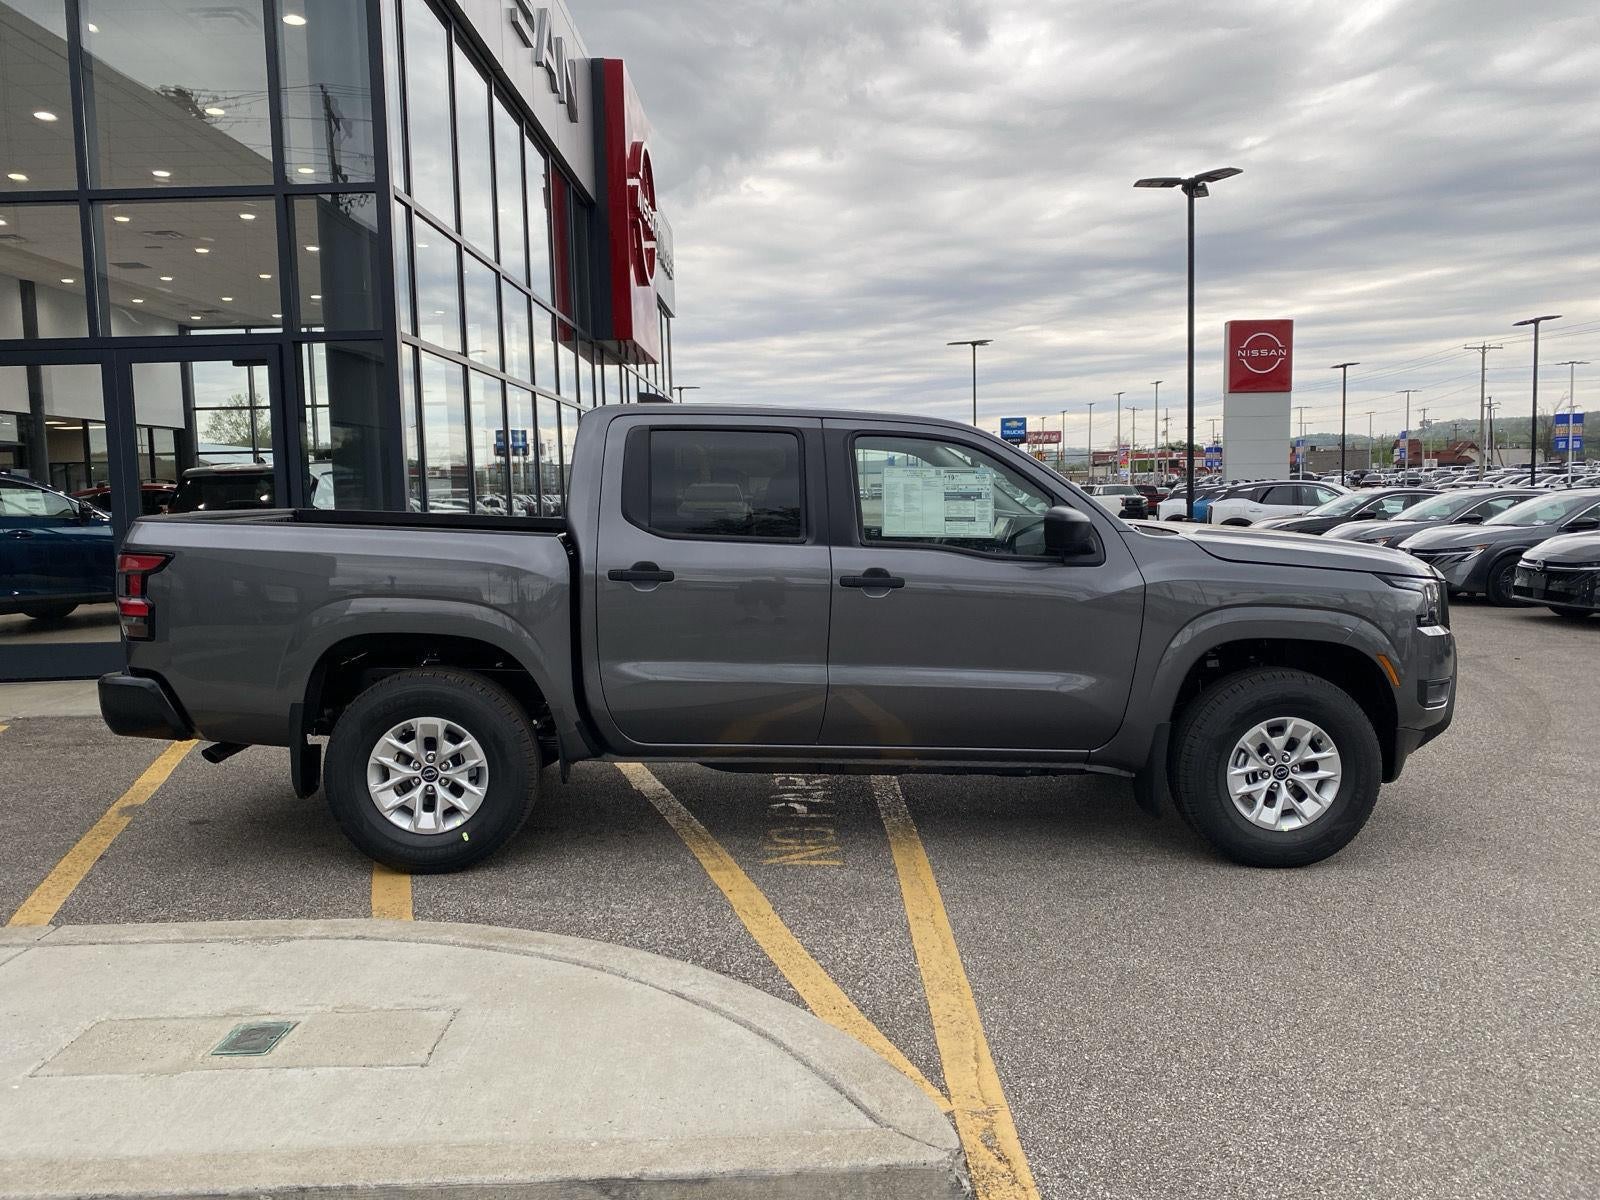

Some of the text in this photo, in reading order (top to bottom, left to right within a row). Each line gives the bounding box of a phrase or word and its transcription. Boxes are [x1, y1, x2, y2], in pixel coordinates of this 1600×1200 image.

[1238, 349, 1287, 357] NISSAN
[760, 772, 845, 866] NO PAR
